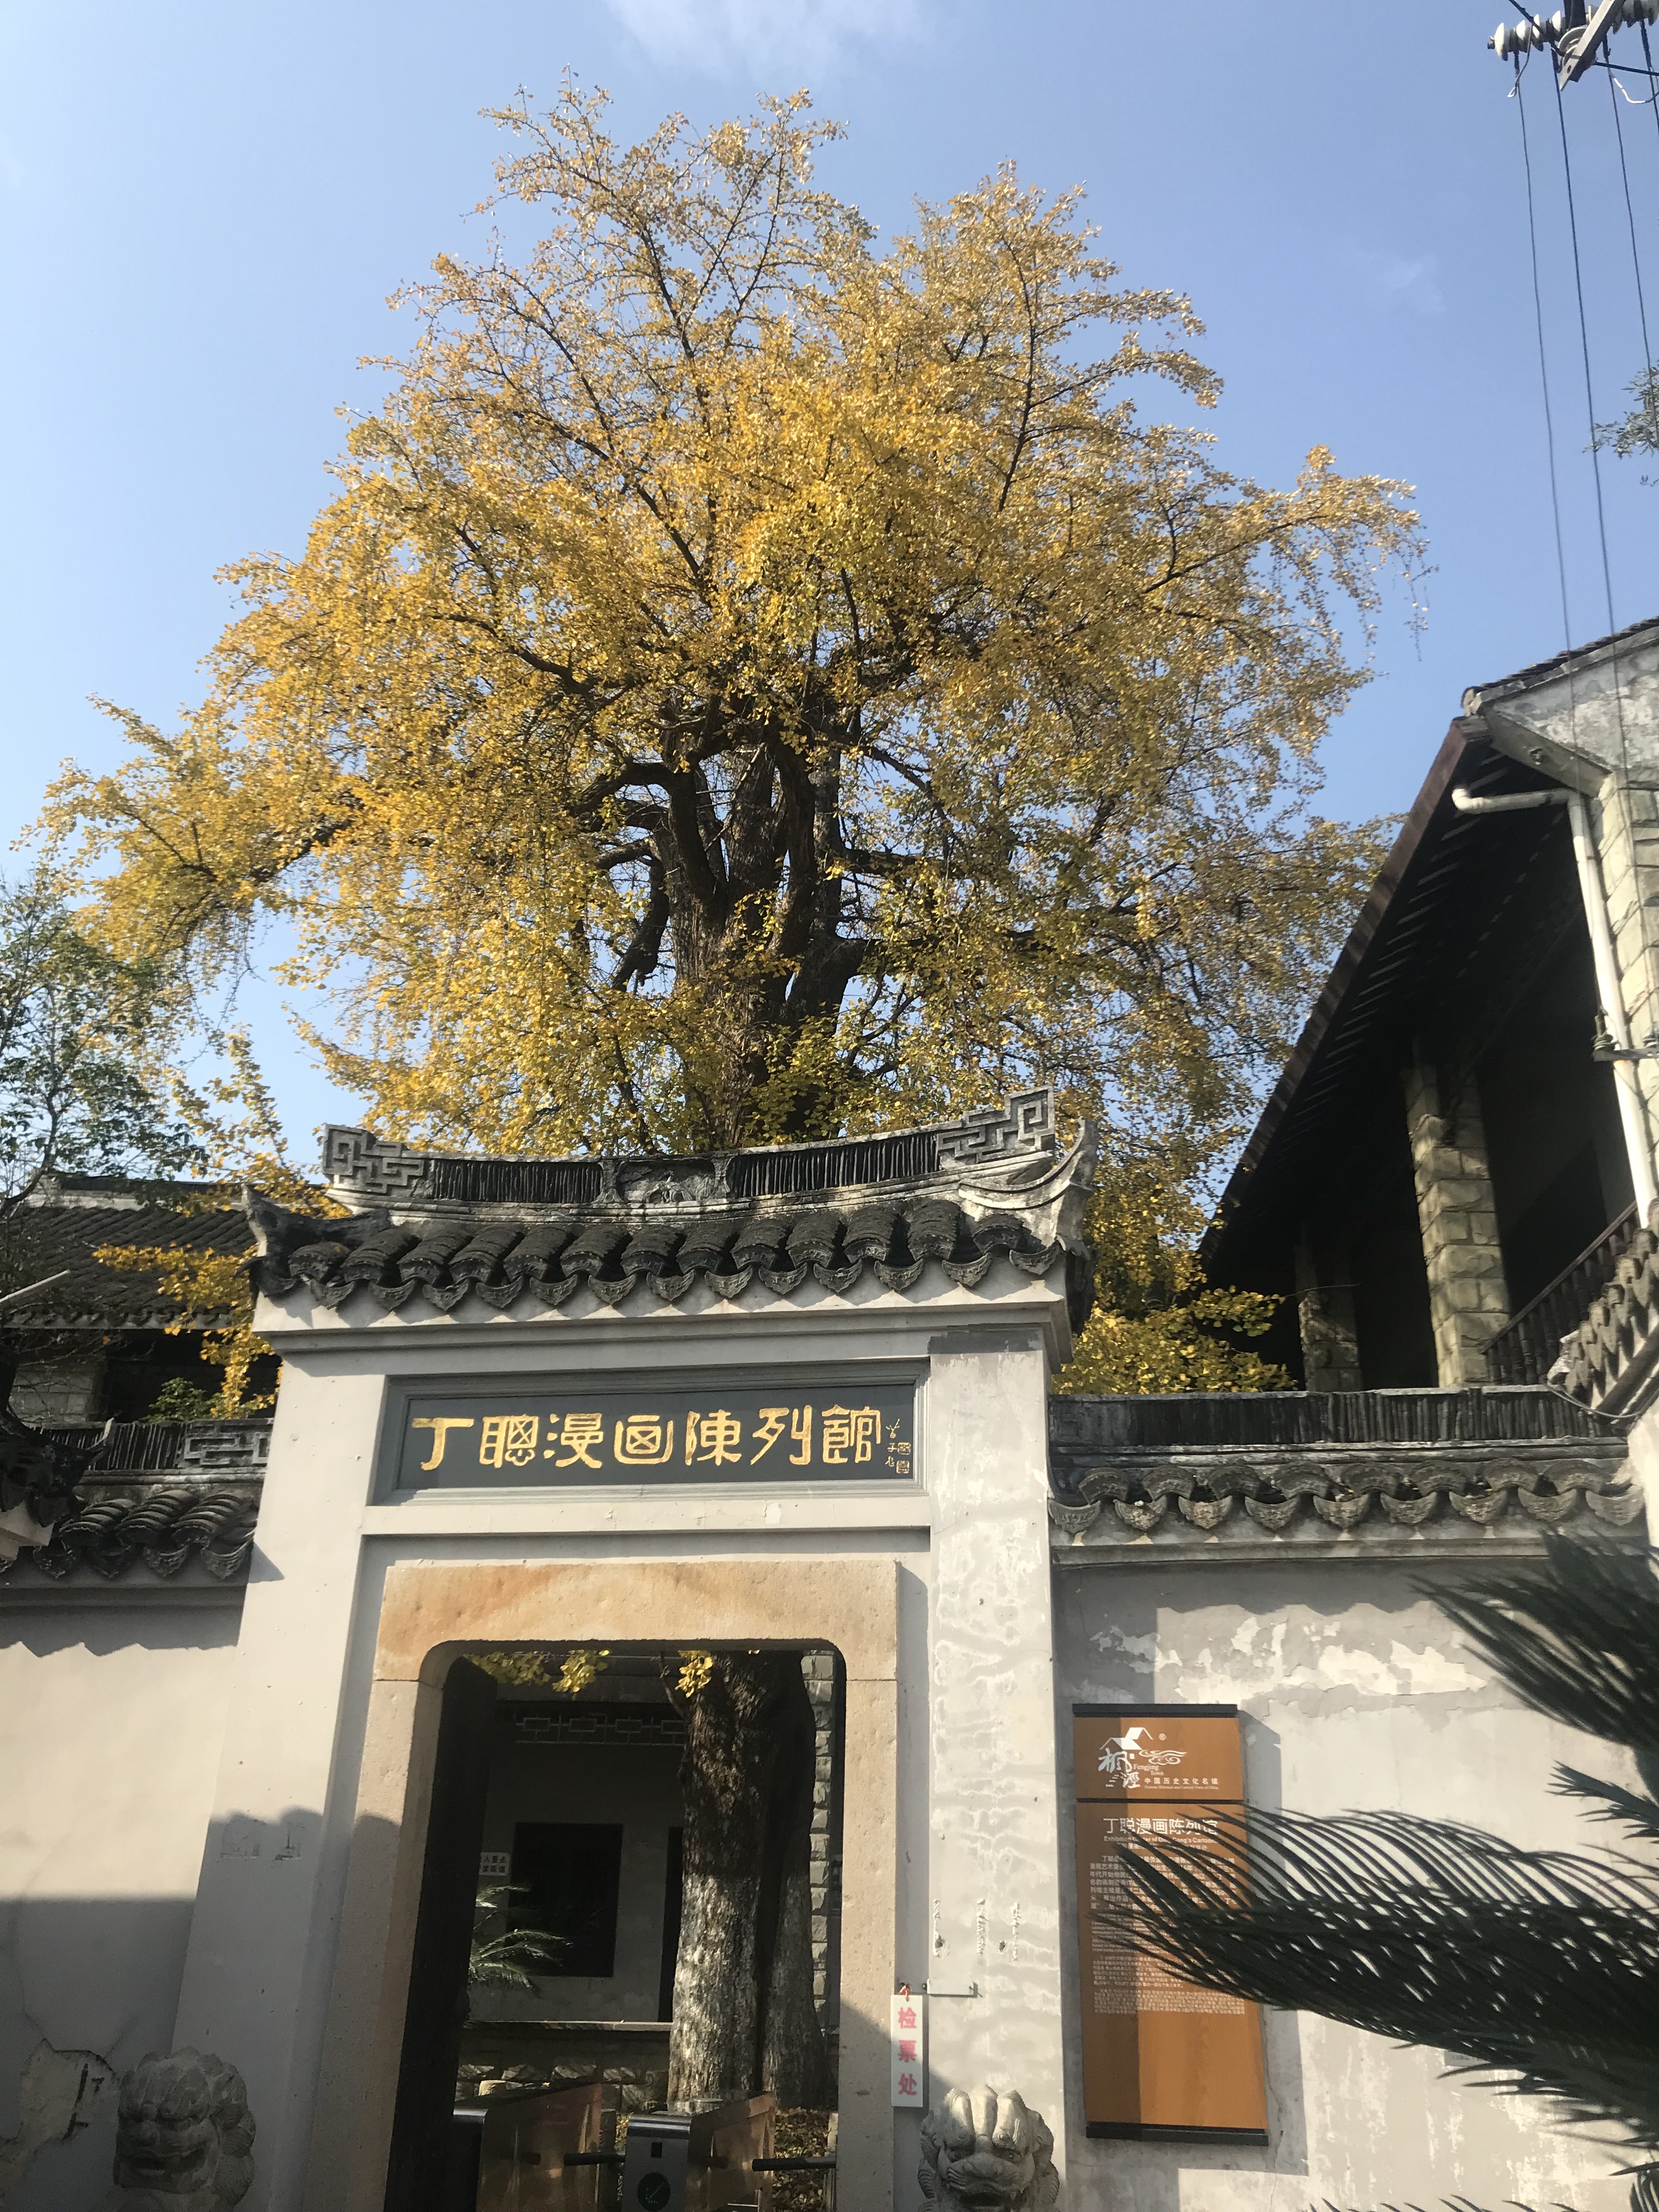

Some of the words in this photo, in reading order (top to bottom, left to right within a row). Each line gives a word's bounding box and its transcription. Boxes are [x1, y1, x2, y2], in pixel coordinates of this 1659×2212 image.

[1144, 1777, 1218, 1785] 中国历史文化名镇
[898, 2007, 917, 2096] 检票处
